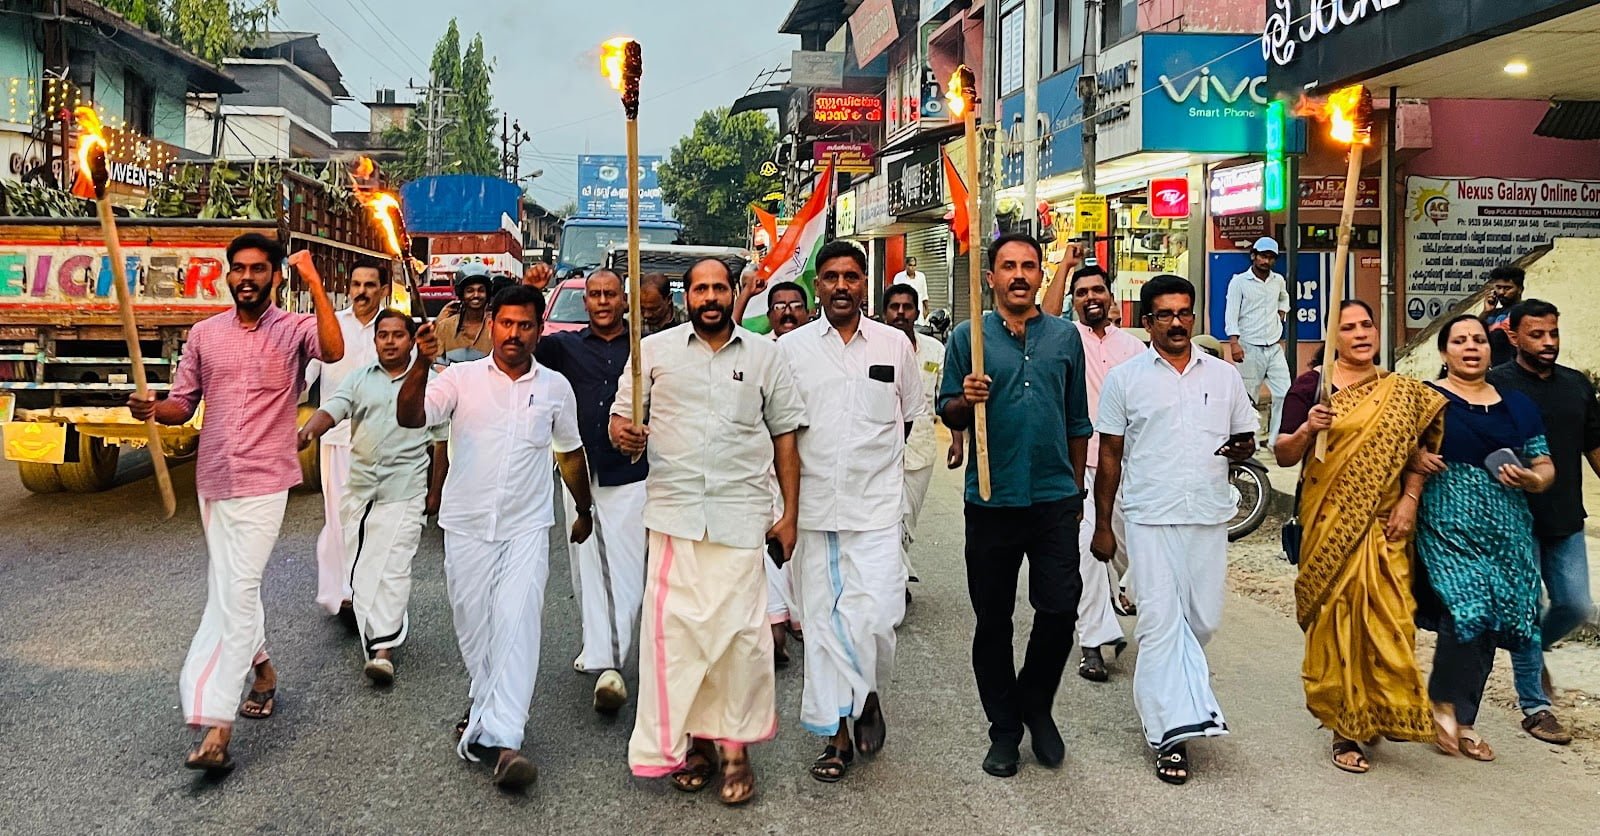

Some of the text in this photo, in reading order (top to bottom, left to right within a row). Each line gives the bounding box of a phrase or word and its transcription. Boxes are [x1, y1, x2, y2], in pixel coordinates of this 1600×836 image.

[1299, 0, 1402, 42] JOC
[1189, 107, 1256, 118] Smart Phone
[1315, 181, 1366, 190] NEXS
[1457, 180, 1494, 200] Nexus
[1498, 182, 1537, 205] Galaxy
[1541, 183, 1577, 202] Online
[1219, 216, 1264, 226] NEXUS
[0, 255, 223, 298] EICHER
